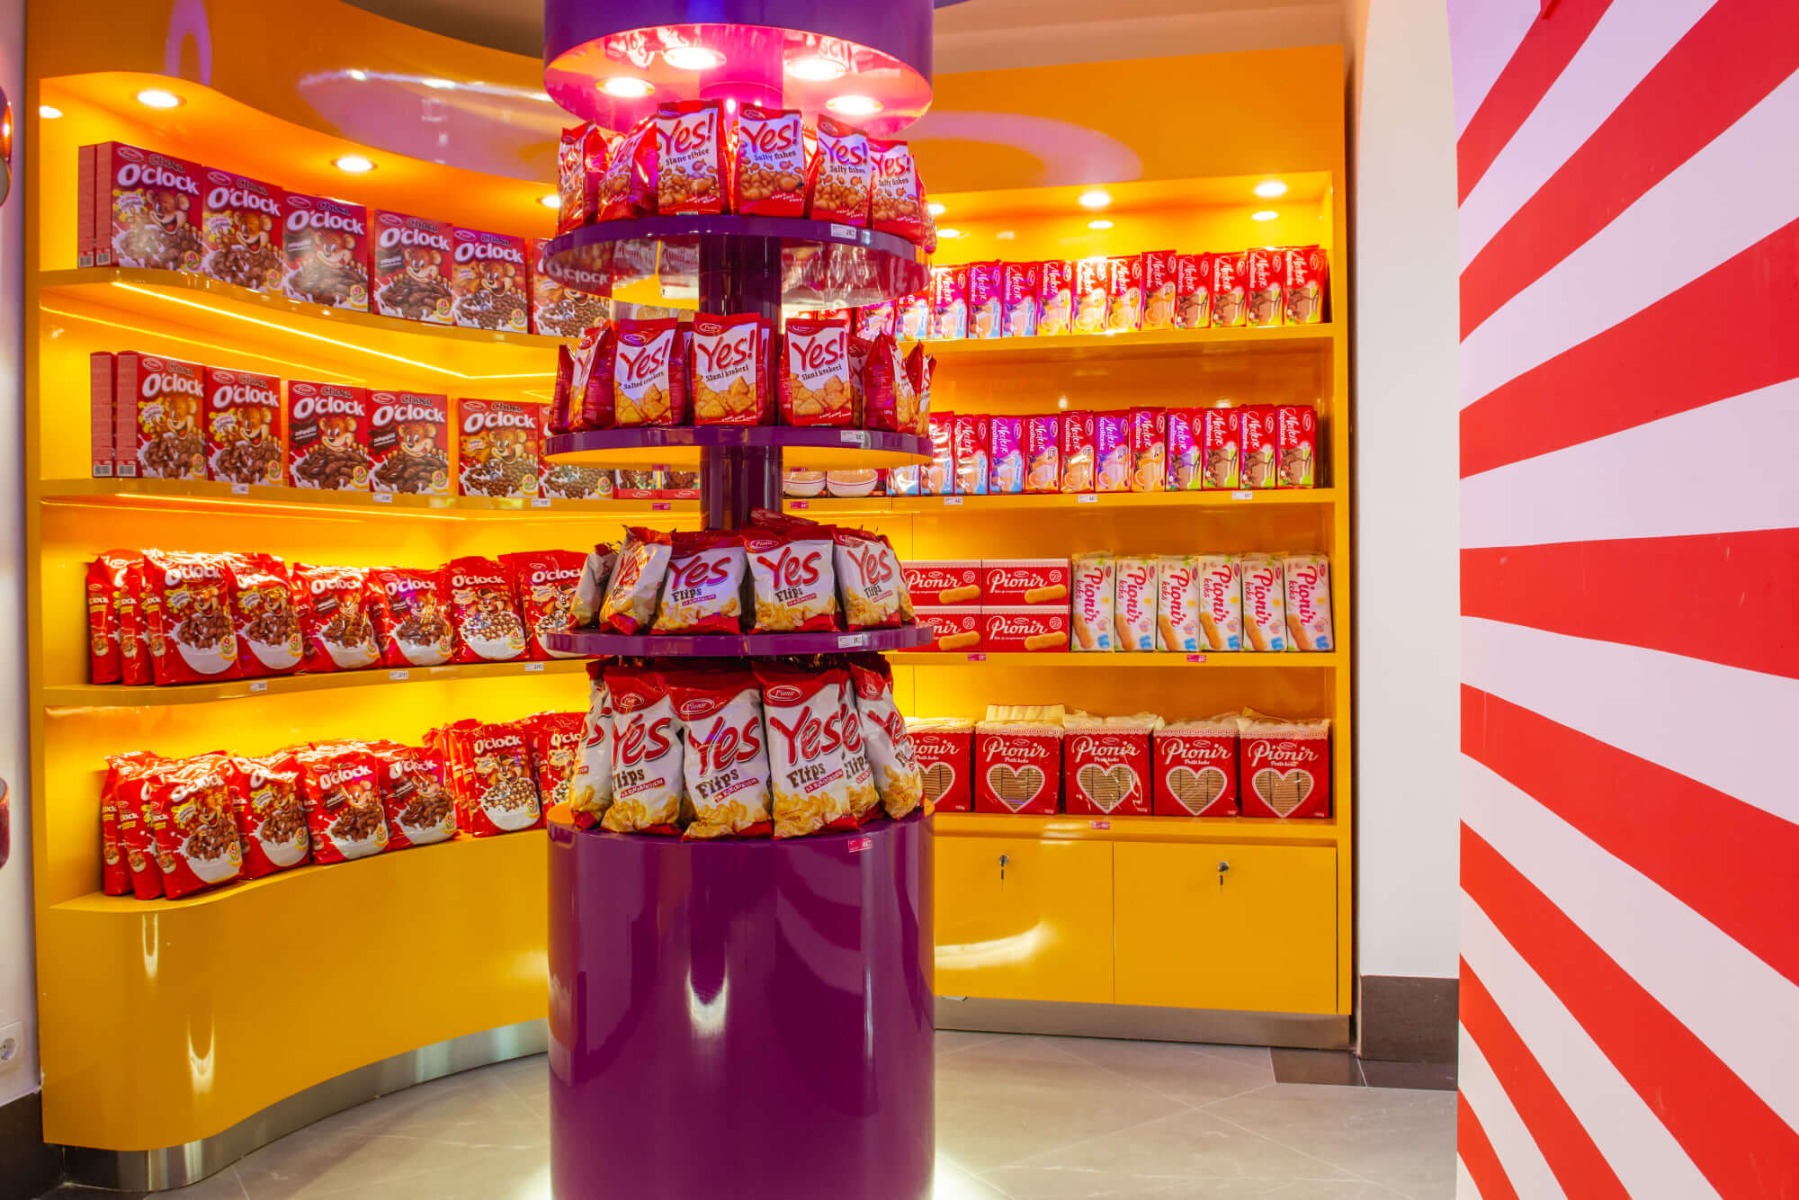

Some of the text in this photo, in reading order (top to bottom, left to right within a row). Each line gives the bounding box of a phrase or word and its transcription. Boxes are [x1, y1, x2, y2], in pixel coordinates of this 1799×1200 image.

[656, 113, 714, 156] Yes!
[740, 119, 799, 153] Yes!
[818, 137, 868, 166] Yes!
[870, 153, 911, 177] Yes!
[117, 164, 199, 195] O'clock
[207, 187, 281, 217] O'clock
[287, 210, 364, 235] O'clock
[379, 227, 450, 251] O'clock
[454, 242, 524, 264] O'clock
[619, 338, 670, 381] Yes!
[697, 330, 755, 372] Yes!
[791, 331, 845, 371] Yes!
[142, 374, 204, 398] O'clock
[213, 385, 280, 408] O'clock
[293, 397, 365, 419] O'clock
[372, 405, 445, 427] O'clock
[464, 412, 536, 433] O'clock
[165, 565, 221, 586] O'clock
[668, 556, 732, 590] Yes
[757, 546, 822, 590] Yes
[847, 545, 893, 587] Yes
[386, 580, 436, 596] O'clock
[452, 574, 506, 588] O'clock
[671, 587, 702, 602] Flips
[775, 587, 803, 602] Flips
[864, 584, 883, 599] Flips
[904, 570, 962, 593] Pionir
[987, 569, 1048, 594] Pionir
[1212, 564, 1232, 624] Pionir
[1084, 566, 1104, 624] Pionir
[1126, 566, 1147, 625] Pionir
[1170, 567, 1190, 627] Pionir
[1253, 568, 1273, 627] Pionir
[1297, 566, 1317, 626] Pionir
[987, 616, 1048, 640] Pionir
[475, 735, 522, 754] O'clock
[551, 732, 582, 747] O'clo
[613, 713, 672, 769] Yes
[689, 716, 760, 776] Yes
[770, 706, 842, 766] Yes
[983, 735, 1050, 763] Pionir
[1071, 736, 1141, 763] Pionir
[1161, 737, 1232, 765] Pionir
[1248, 740, 1319, 768] Pionir
[319, 766, 372, 790] O'clock
[390, 760, 437, 780] O'clock
[695, 768, 739, 799] Flips
[787, 762, 826, 788] Flips
